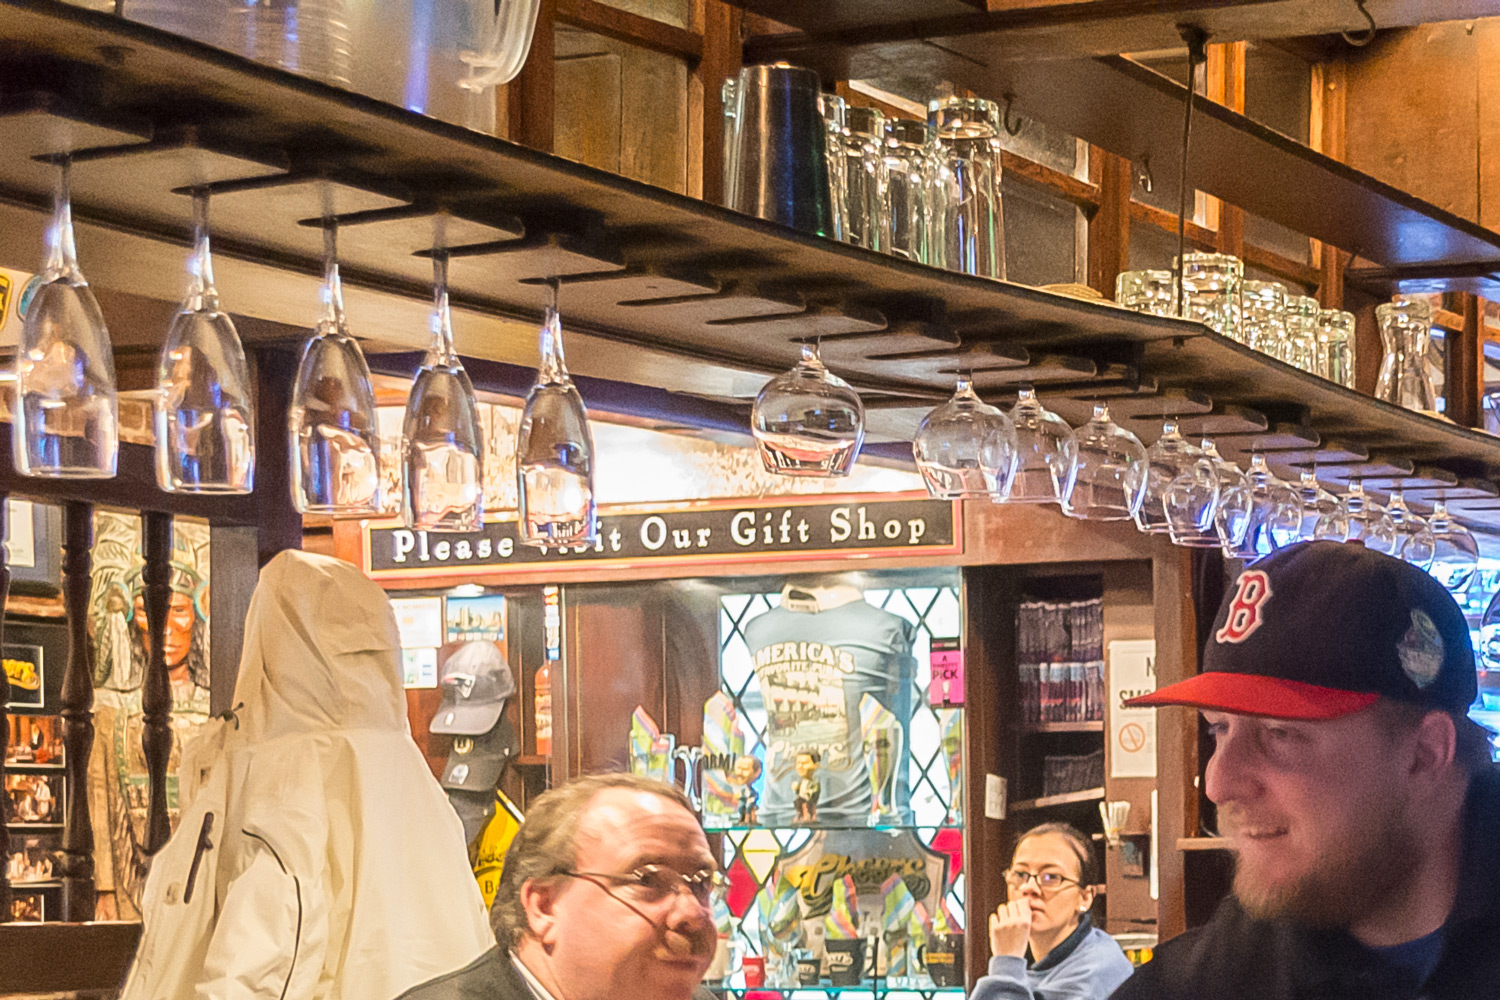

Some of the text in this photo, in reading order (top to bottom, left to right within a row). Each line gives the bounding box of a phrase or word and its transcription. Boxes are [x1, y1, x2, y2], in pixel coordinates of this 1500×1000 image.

[393, 529, 514, 563] Please
[640, 516, 711, 550] Our
[730, 510, 810, 545] Gift
[830, 507, 926, 544] Shop
[1235, 570, 1274, 644] B
[1146, 657, 1156, 677] N
